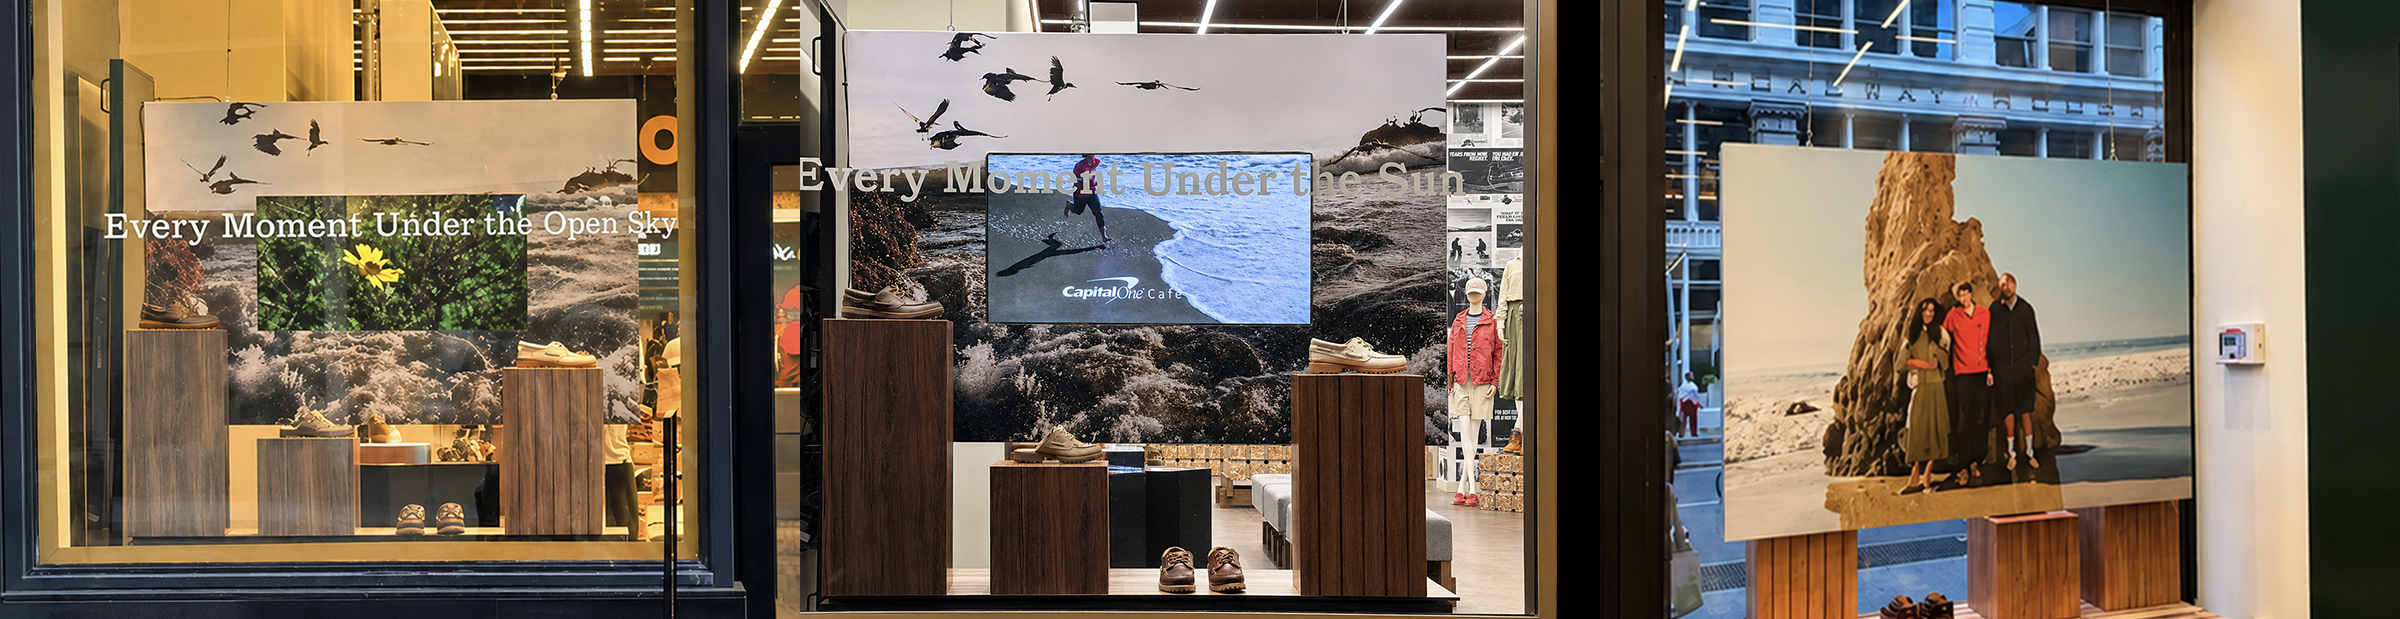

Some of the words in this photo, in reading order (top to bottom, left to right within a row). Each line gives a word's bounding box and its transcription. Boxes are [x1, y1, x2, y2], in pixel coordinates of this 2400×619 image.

[800, 157, 929, 203] Every
[943, 160, 1125, 195] Moment
[1140, 160, 1277, 197] Under
[1290, 161, 1362, 197] the
[1379, 161, 1466, 198] Sun
[103, 213, 210, 246] Every
[222, 212, 363, 238] Moment
[373, 211, 475, 237] Under
[484, 211, 533, 236] the
[543, 211, 619, 240] Open
[628, 211, 678, 239] Sky
